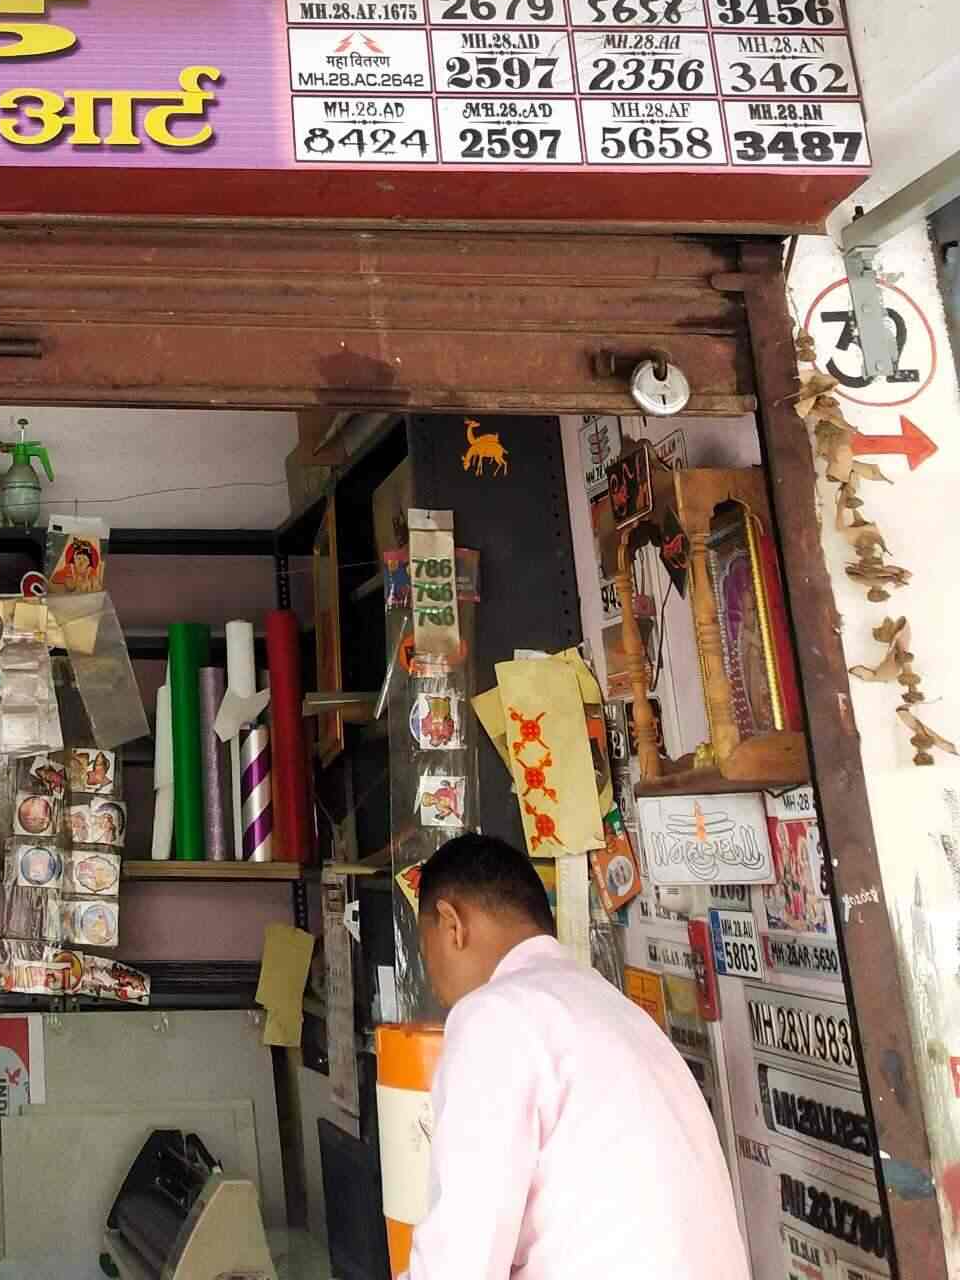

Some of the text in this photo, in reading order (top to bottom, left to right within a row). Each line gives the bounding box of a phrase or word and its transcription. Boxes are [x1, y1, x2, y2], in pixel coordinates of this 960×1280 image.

[300, 2, 417, 21] MH.28.AF.1675
[462, 33, 540, 50] MH.28.AD
[739, 36, 825, 54] MH.28.AN
[298, 72, 424, 88] MH.28.AC.2642
[446, 56, 559, 90] 2597
[589, 57, 705, 93] 2356
[729, 62, 849, 94] 3462
[462, 102, 553, 118] MH.28.AD
[611, 102, 690, 119] MH.28.AF
[748, 104, 823, 121] MH.28.AN
[304, 127, 429, 158] 8424
[458, 128, 561, 159] 2597
[601, 127, 712, 160] 5658
[734, 130, 863, 163] 3487
[725, 941, 758, 973] 5803
